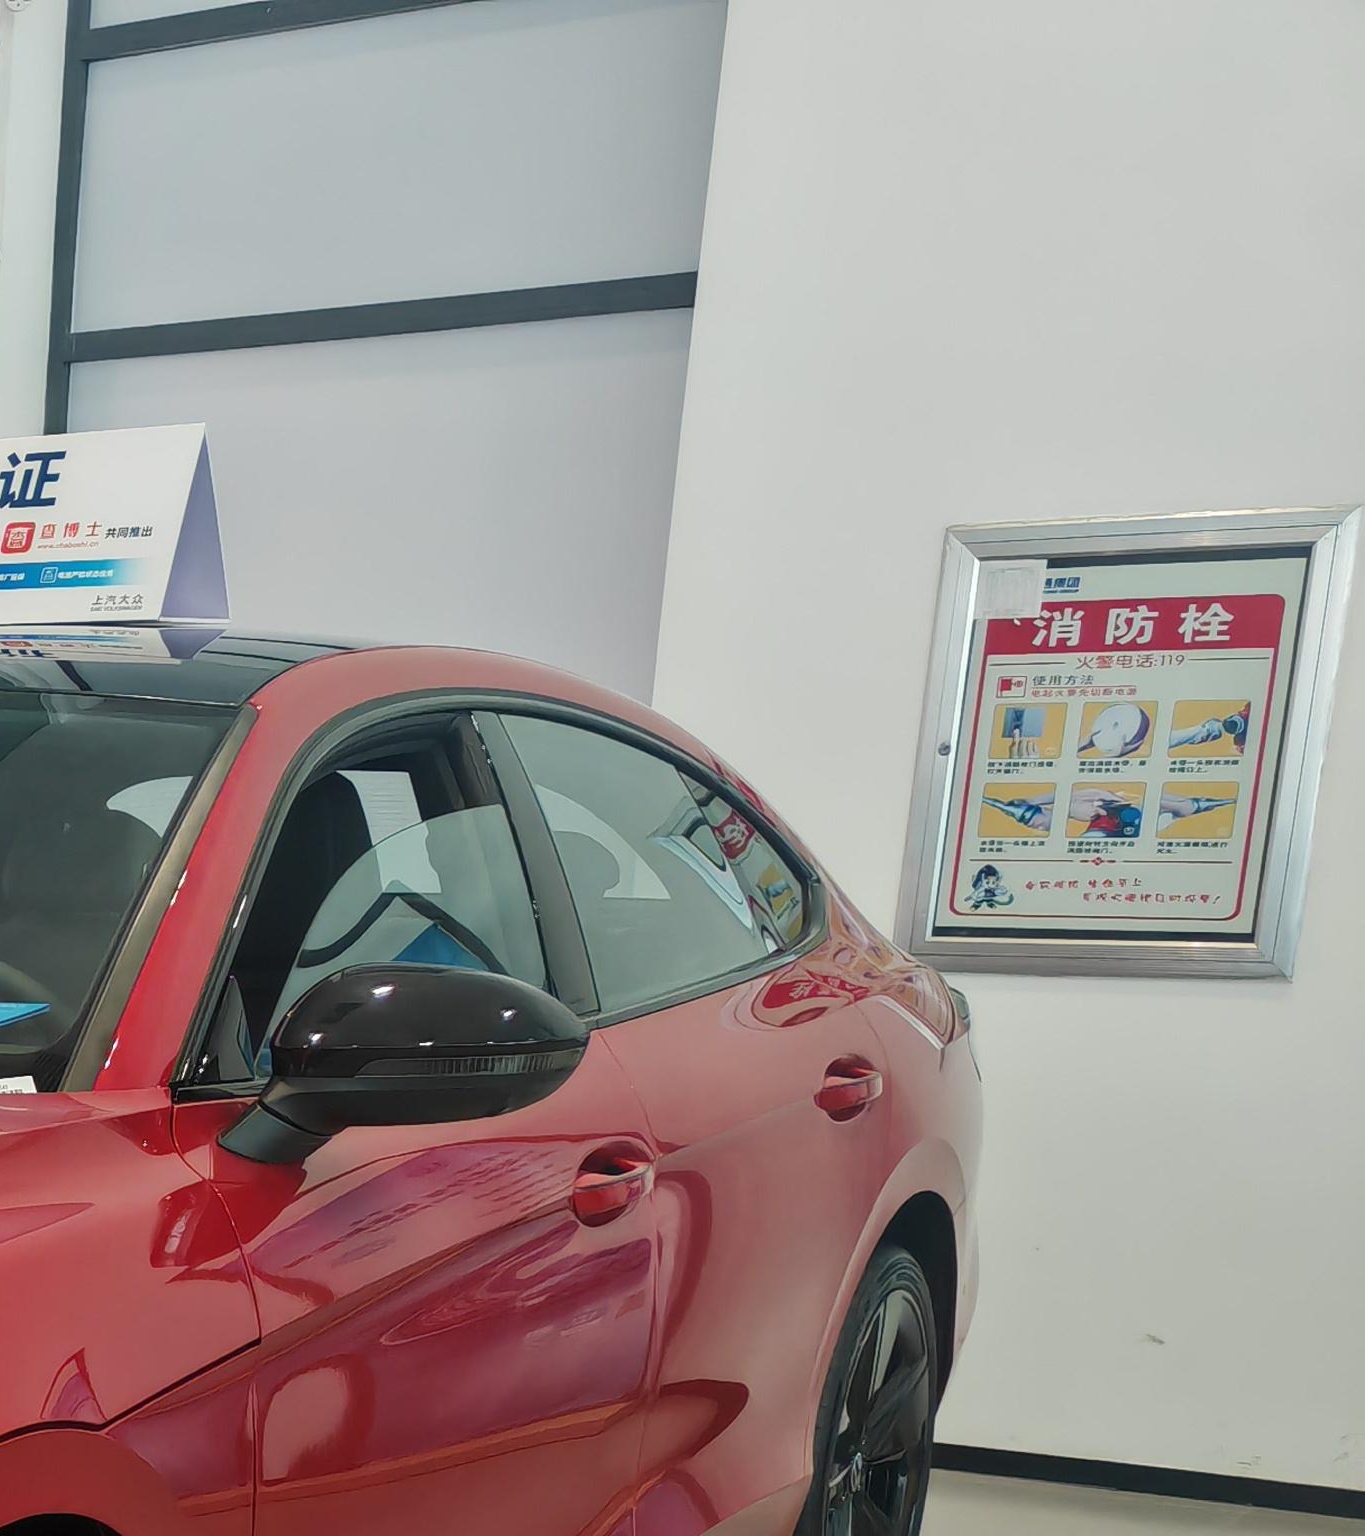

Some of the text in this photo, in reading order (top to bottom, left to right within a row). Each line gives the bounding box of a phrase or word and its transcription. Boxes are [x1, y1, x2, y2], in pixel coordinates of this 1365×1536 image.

[39, 521, 102, 540] 查博士
[105, 525, 153, 539] 共同推出
[91, 593, 144, 605] 上汽大众
[1031, 602, 1234, 648] 消防栓
[1032, 674, 1094, 686] 使用方法
